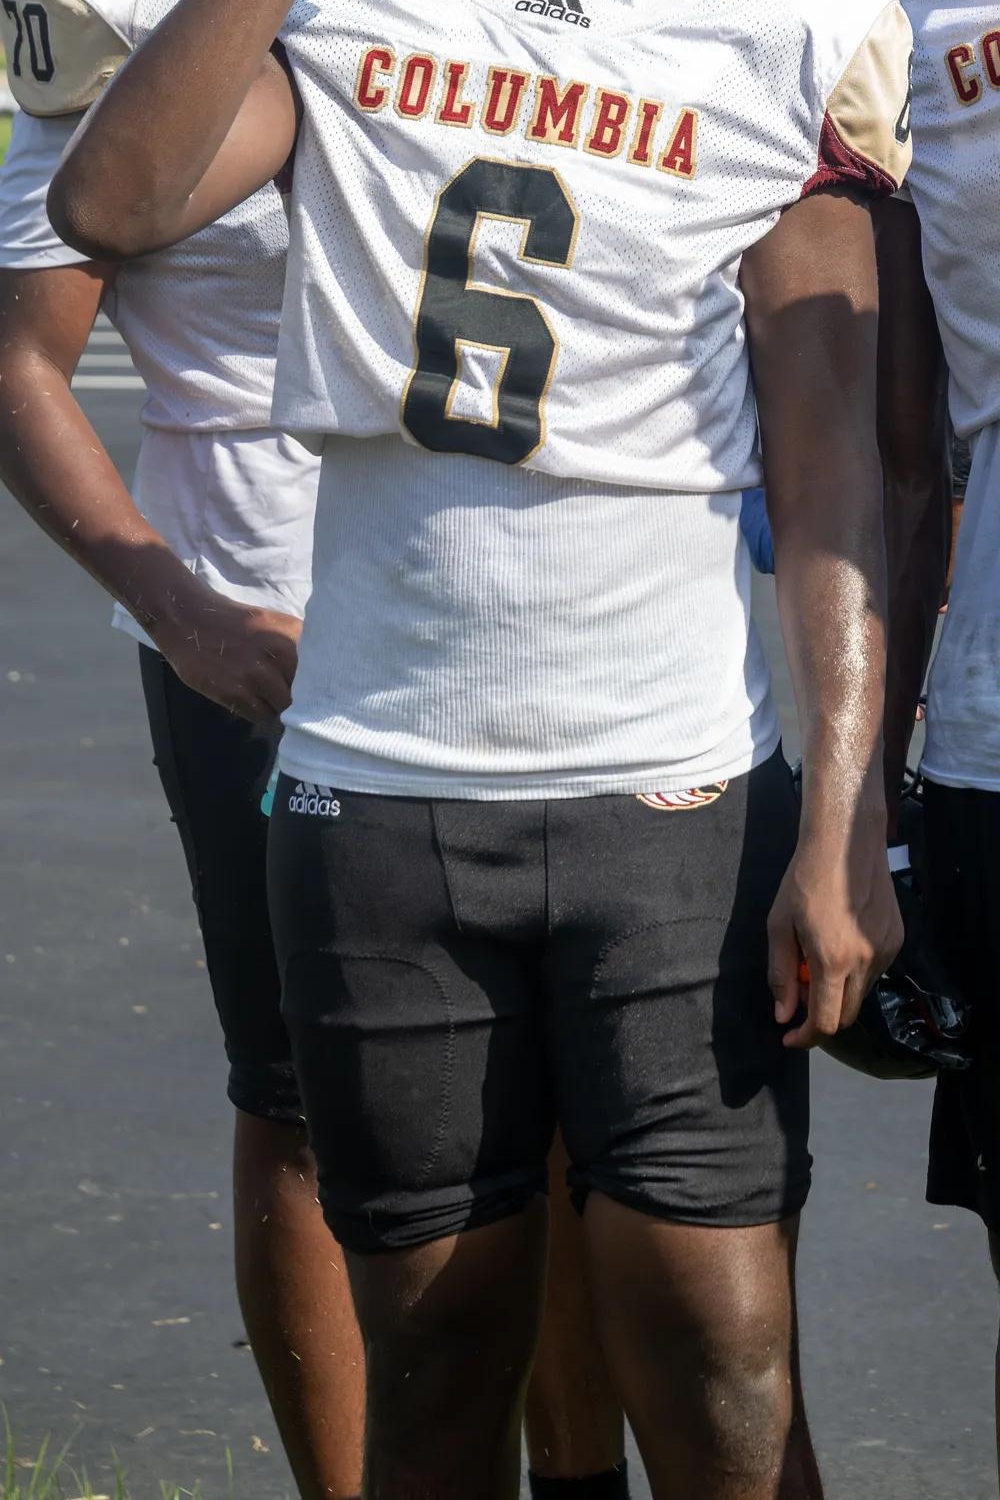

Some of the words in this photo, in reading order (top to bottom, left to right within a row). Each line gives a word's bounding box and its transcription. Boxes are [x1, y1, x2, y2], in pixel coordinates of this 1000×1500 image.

[514, 0, 592, 29] adidas
[356, 45, 700, 181] COLUMBIA
[400, 156, 581, 466] 6
[288, 792, 341, 817] adidas
